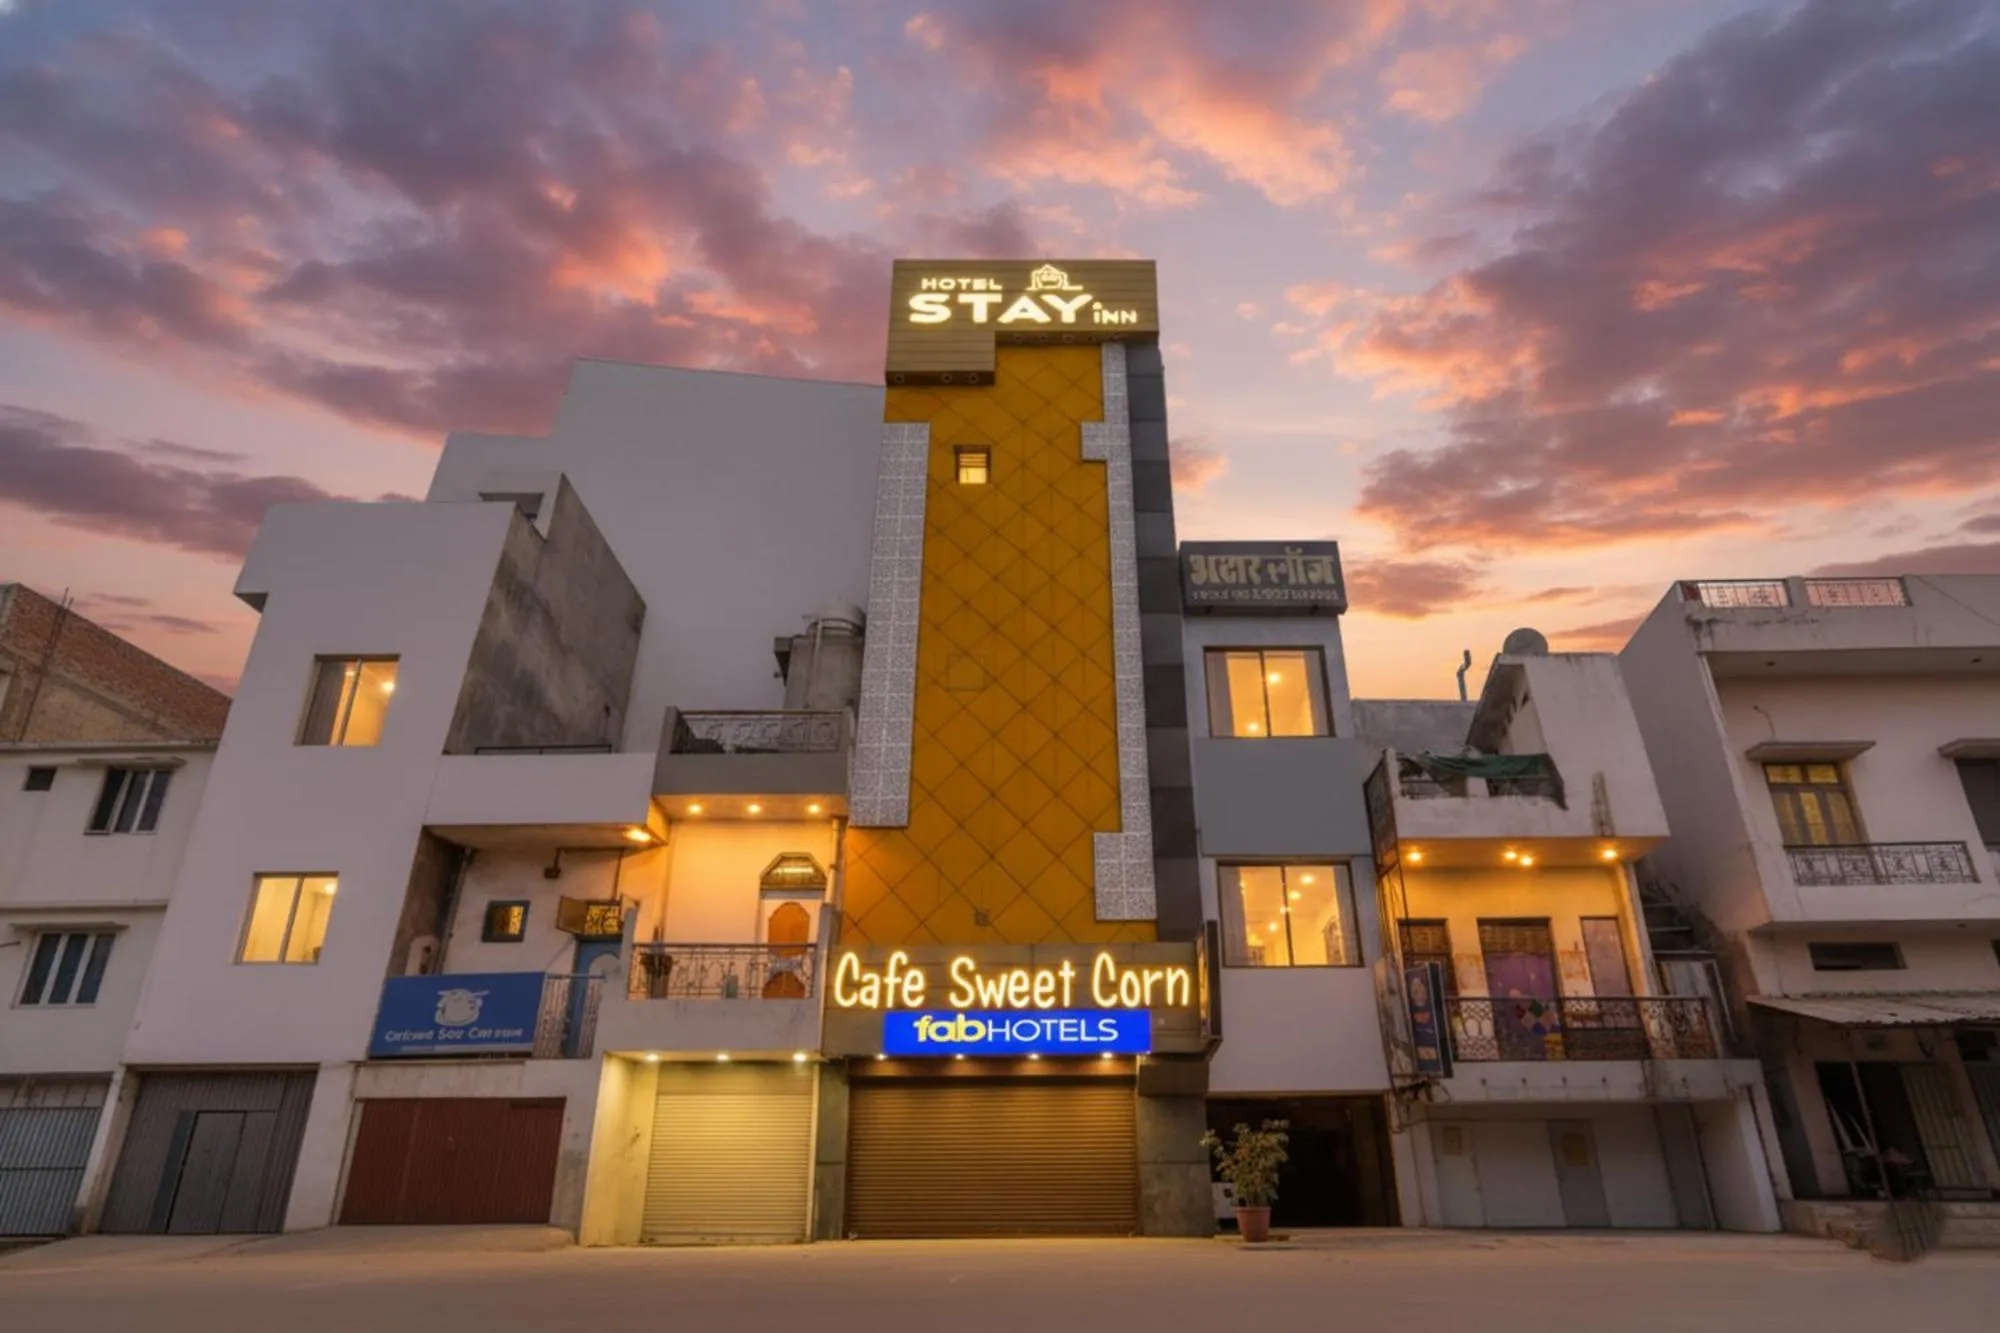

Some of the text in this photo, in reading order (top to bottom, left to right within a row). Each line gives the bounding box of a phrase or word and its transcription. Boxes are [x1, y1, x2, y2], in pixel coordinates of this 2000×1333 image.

[920, 277, 1003, 290] HOTEL
[908, 293, 1093, 324] STAY
[834, 951, 1190, 1008] Cafe Sweet Corn
